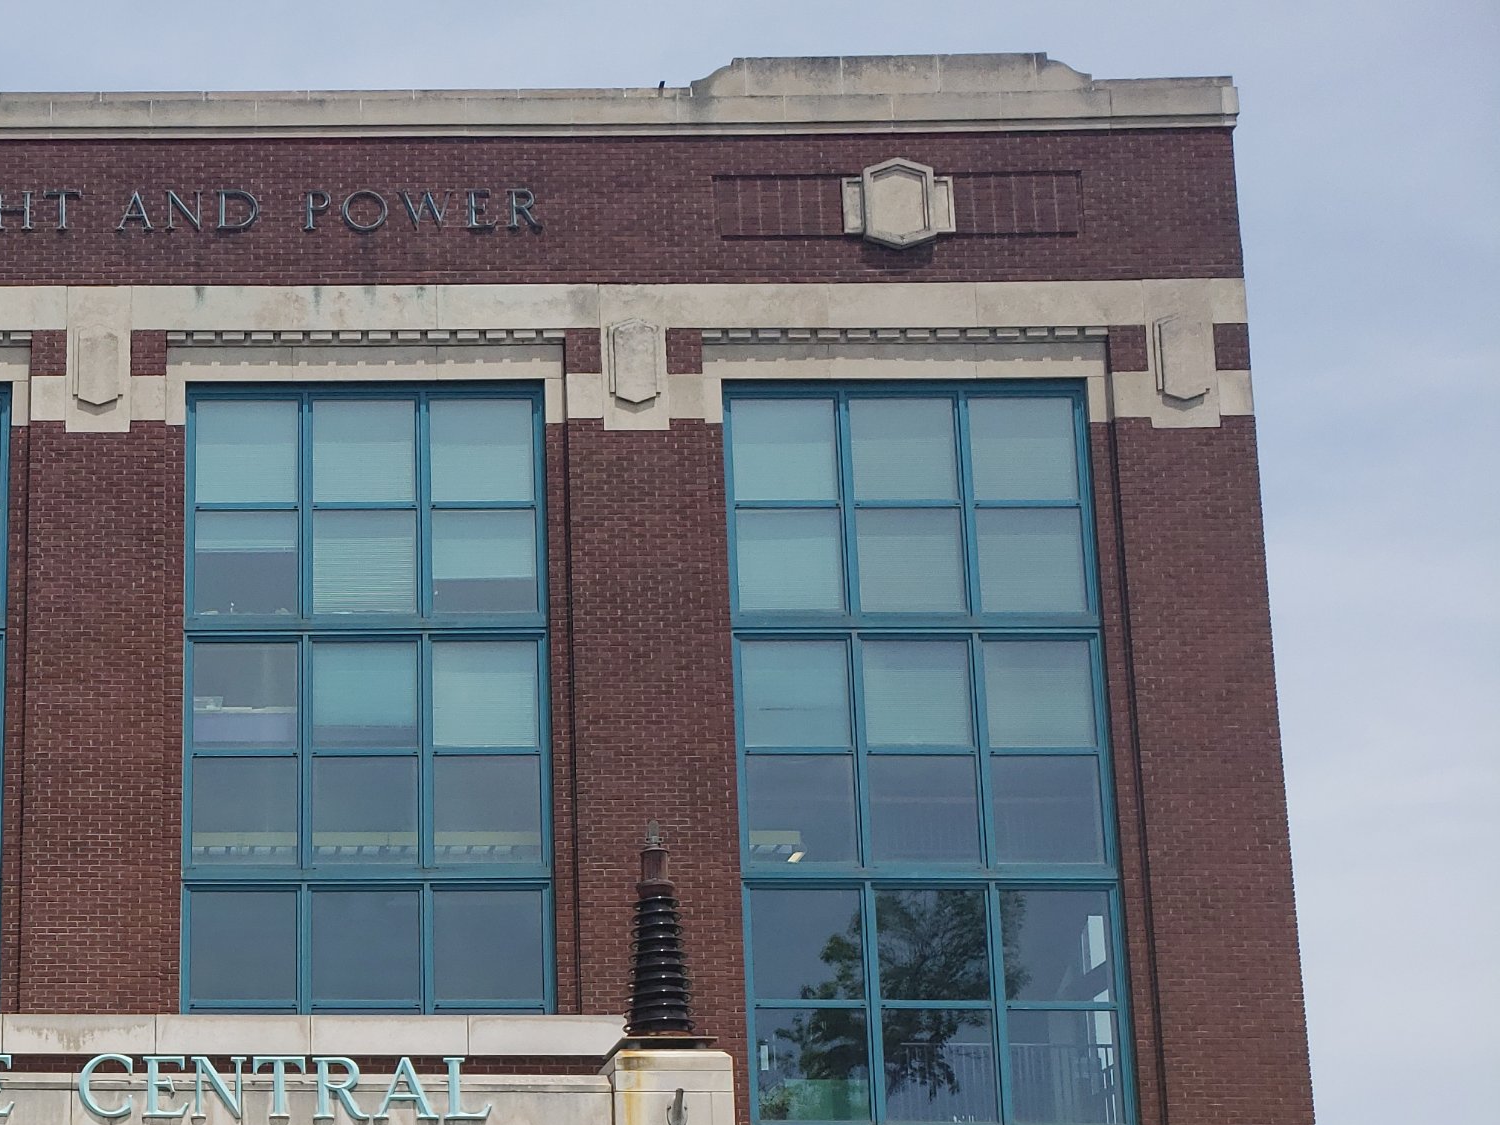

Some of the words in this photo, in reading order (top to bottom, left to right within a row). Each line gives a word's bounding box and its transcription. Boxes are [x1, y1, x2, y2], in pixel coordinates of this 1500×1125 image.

[116, 190, 260, 231] AND
[304, 190, 543, 232] POWER
[78, 1053, 492, 1119] CENTRAL
